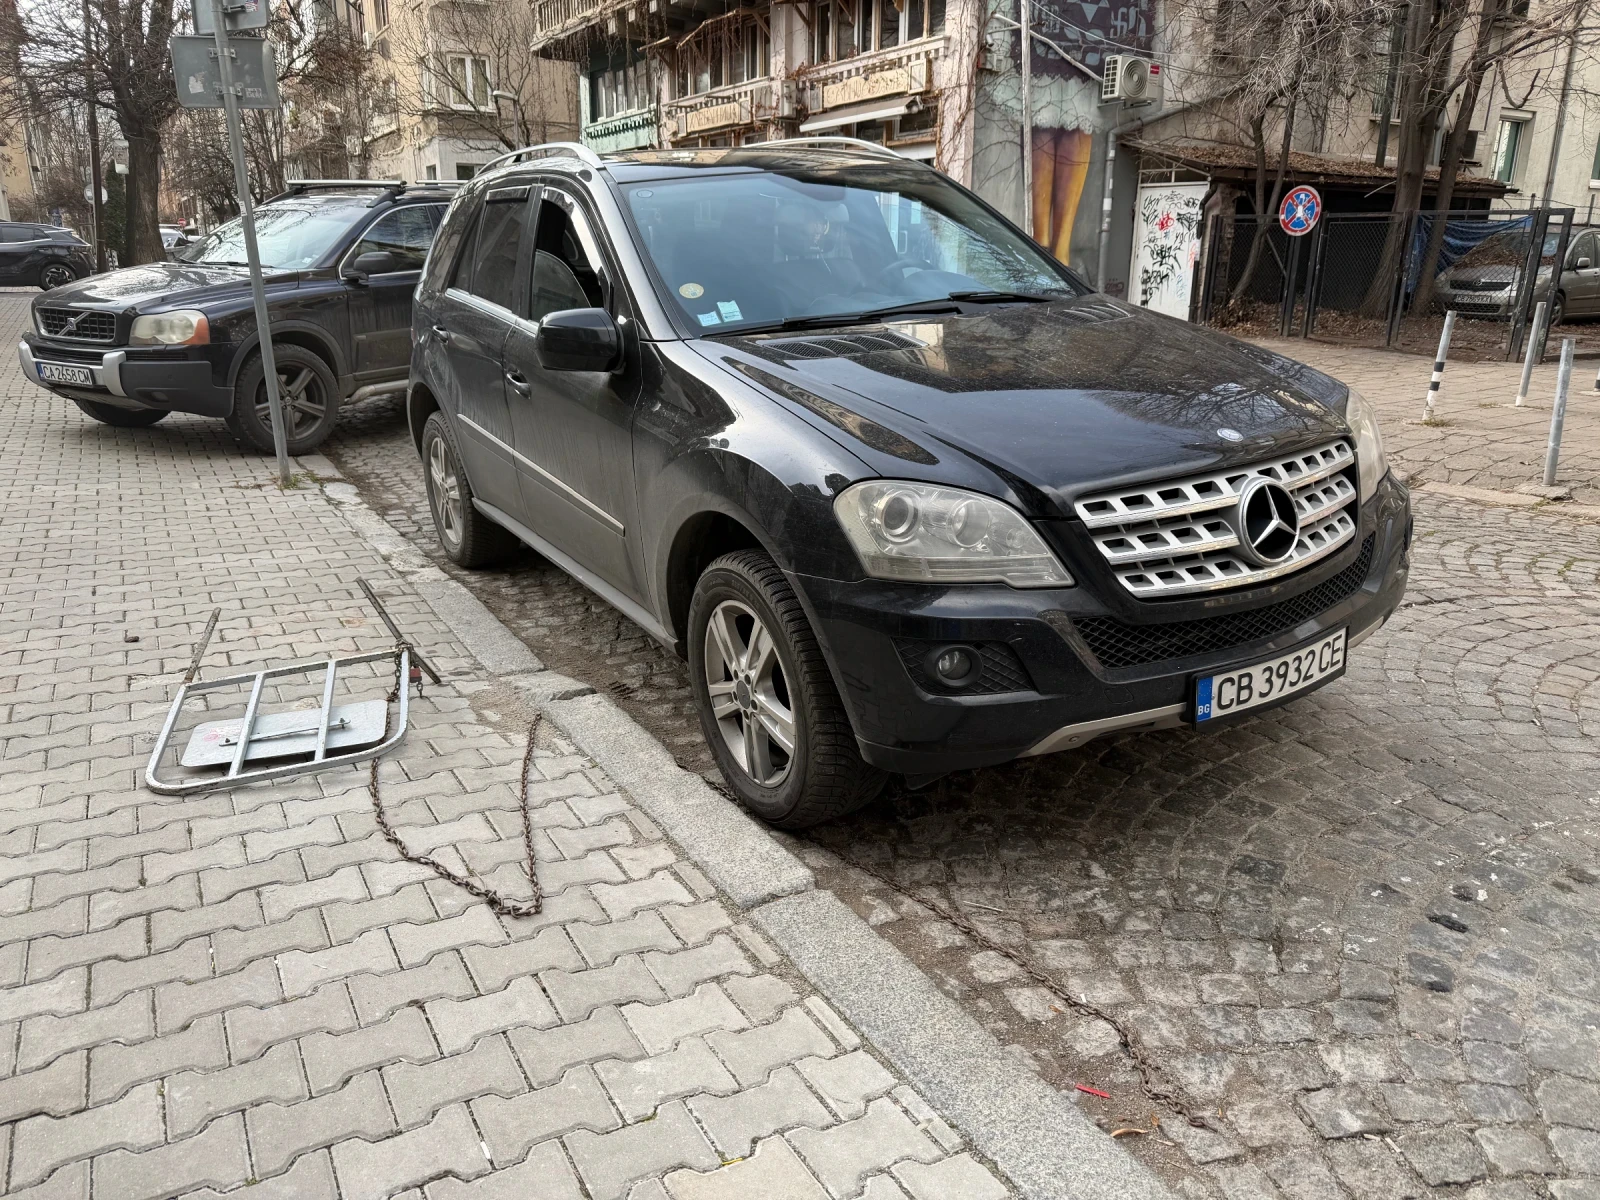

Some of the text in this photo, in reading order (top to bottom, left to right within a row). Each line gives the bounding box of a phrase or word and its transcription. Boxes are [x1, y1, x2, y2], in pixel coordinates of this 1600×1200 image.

[42, 366, 56, 380] CA
[56, 367, 77, 382] 2658
[78, 369, 91, 383] CM
[1217, 634, 1342, 710] CB 3932 CE
[1197, 703, 1210, 716] BG
